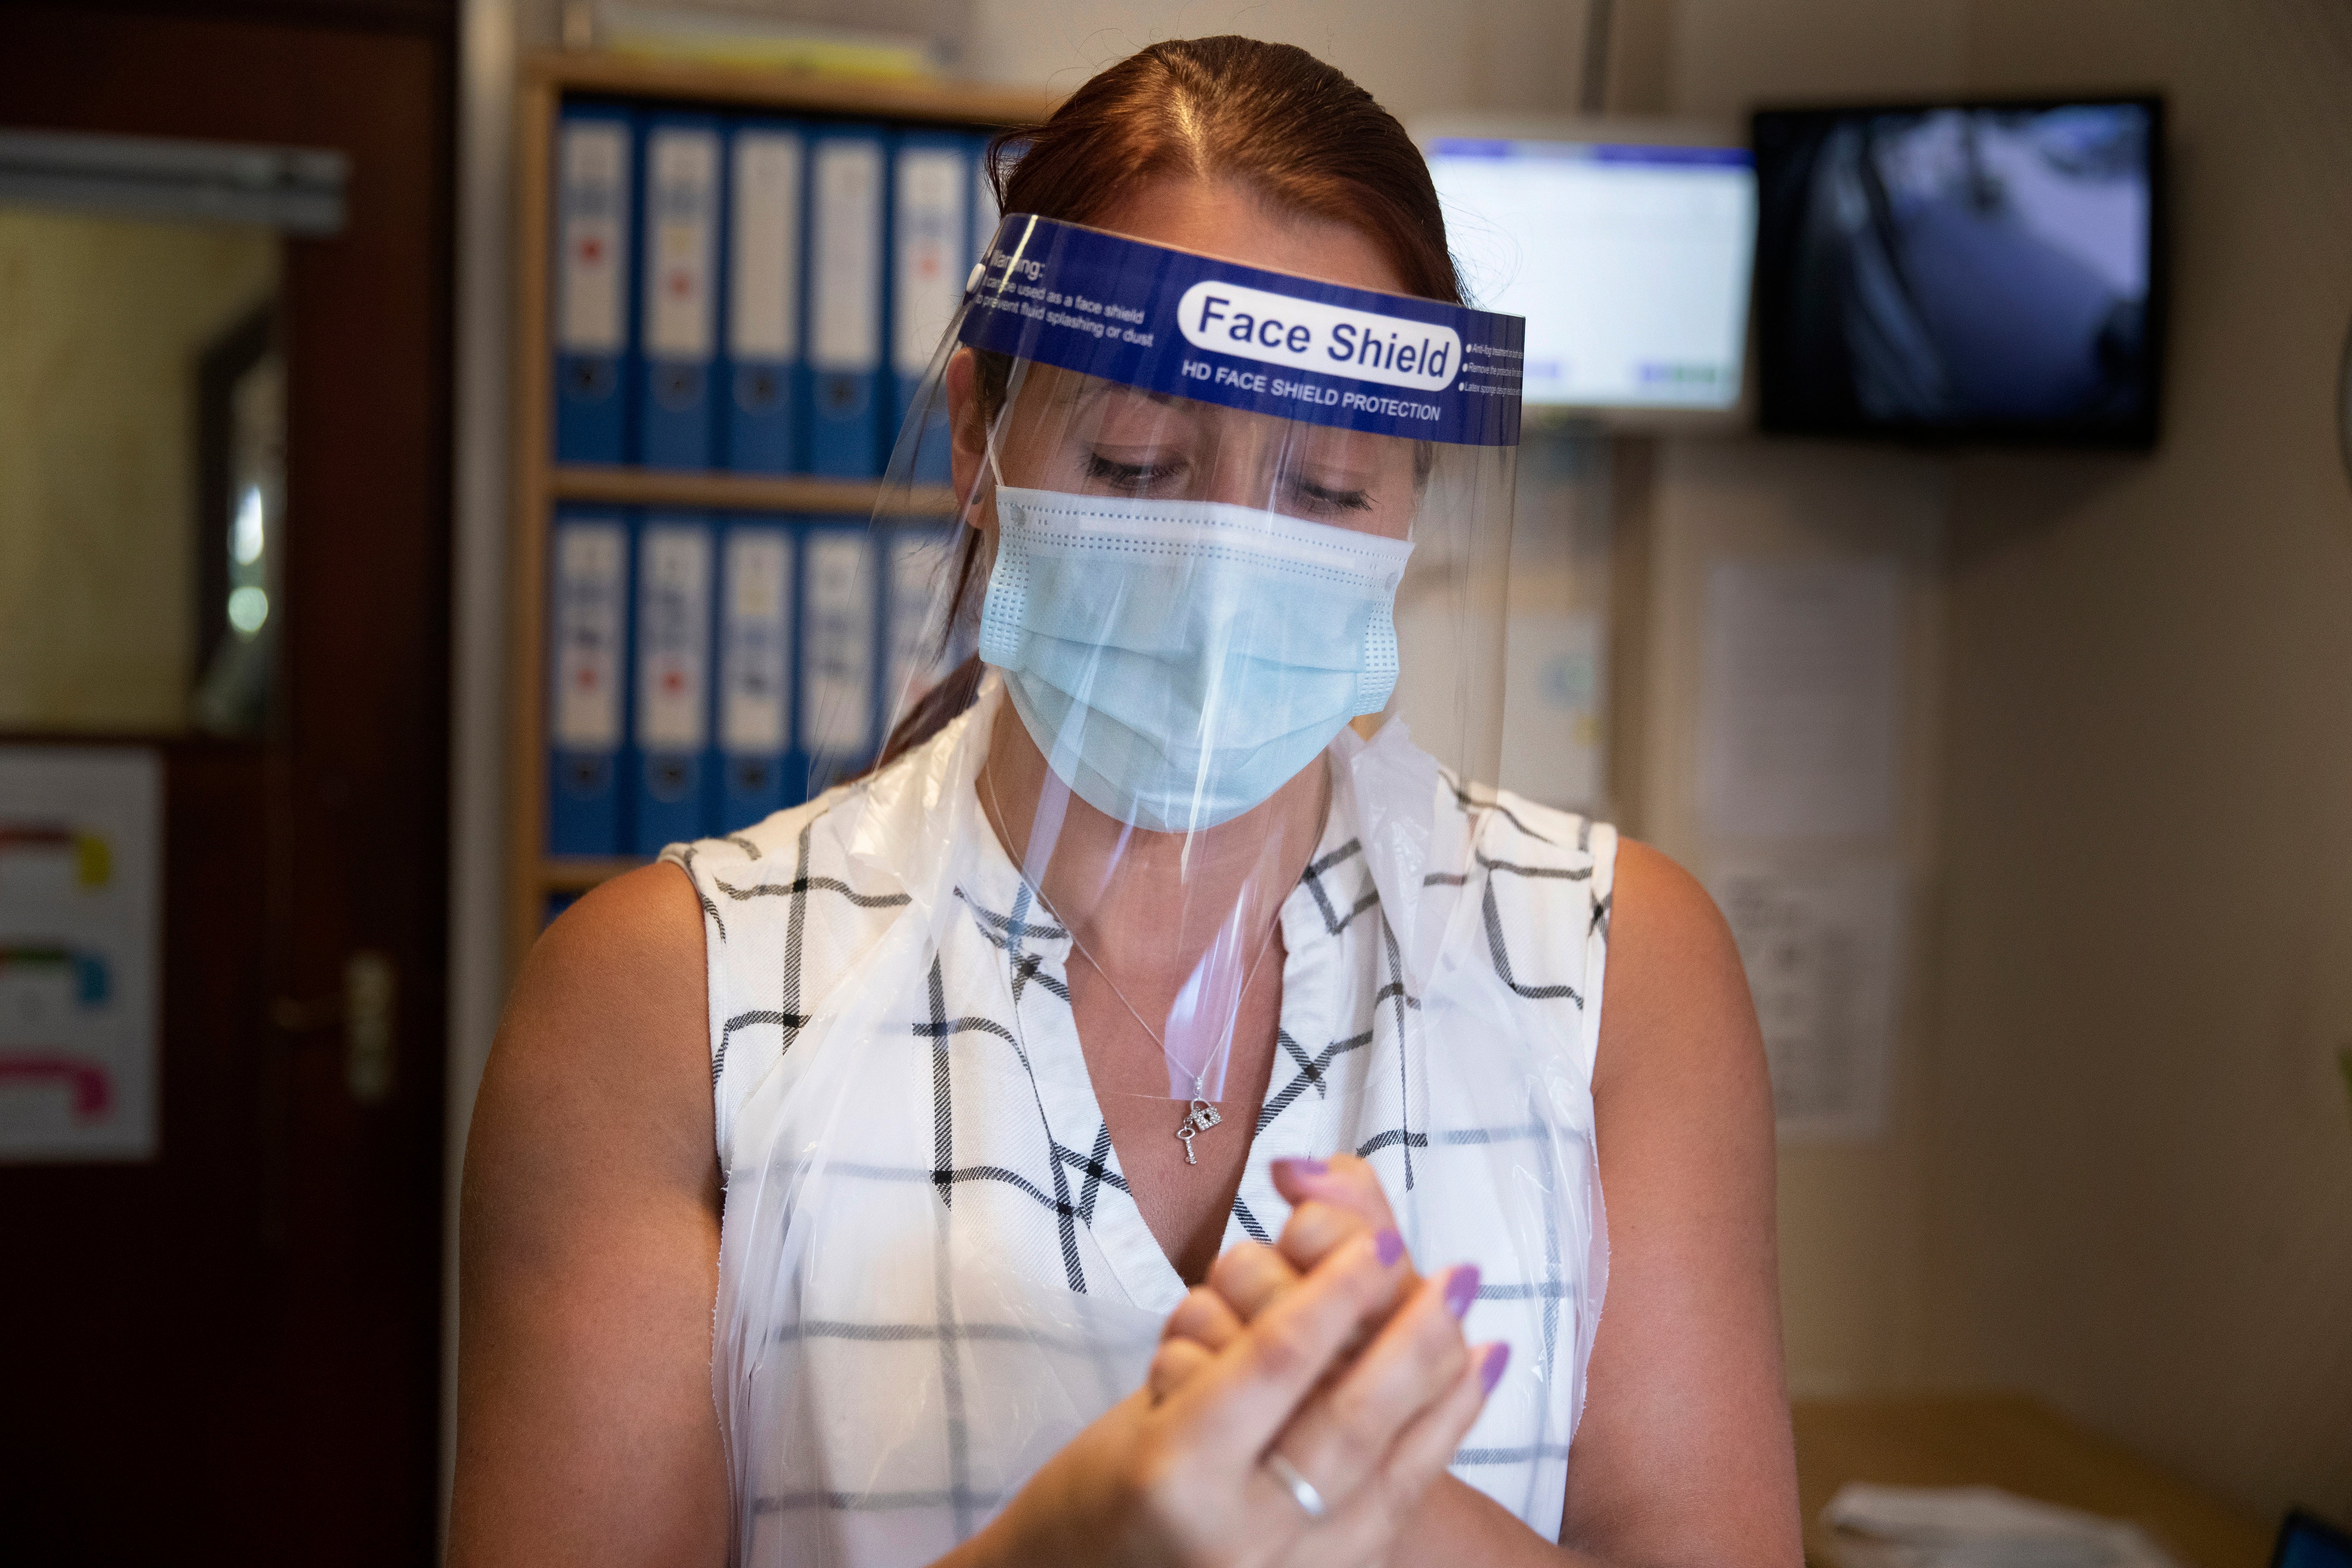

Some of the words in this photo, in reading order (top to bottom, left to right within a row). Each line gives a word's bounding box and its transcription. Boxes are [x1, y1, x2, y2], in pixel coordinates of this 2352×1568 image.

[983, 296, 1020, 314] prevent
[1020, 302, 1046, 320] fluid
[1045, 311, 1105, 338] splashing
[1106, 326, 1122, 338] or
[1122, 328, 1153, 348] dust
[1017, 284, 1046, 300] used
[1046, 291, 1063, 305] as
[1063, 295, 1073, 307] a
[1075, 295, 1103, 315] face
[1103, 304, 1145, 325] shield
[1198, 295, 1310, 353] Face
[1327, 323, 1450, 378] Shield
[1471, 343, 1492, 358] Anti-fog
[1468, 362, 1490, 374] Remove
[1182, 359, 1212, 380] HD
[1214, 367, 1268, 393] FACE
[1270, 378, 1339, 406] SHIELD
[1341, 392, 1441, 421] PROTECTION
[1464, 382, 1479, 392] Latex
[1479, 385, 1497, 397] sponge
